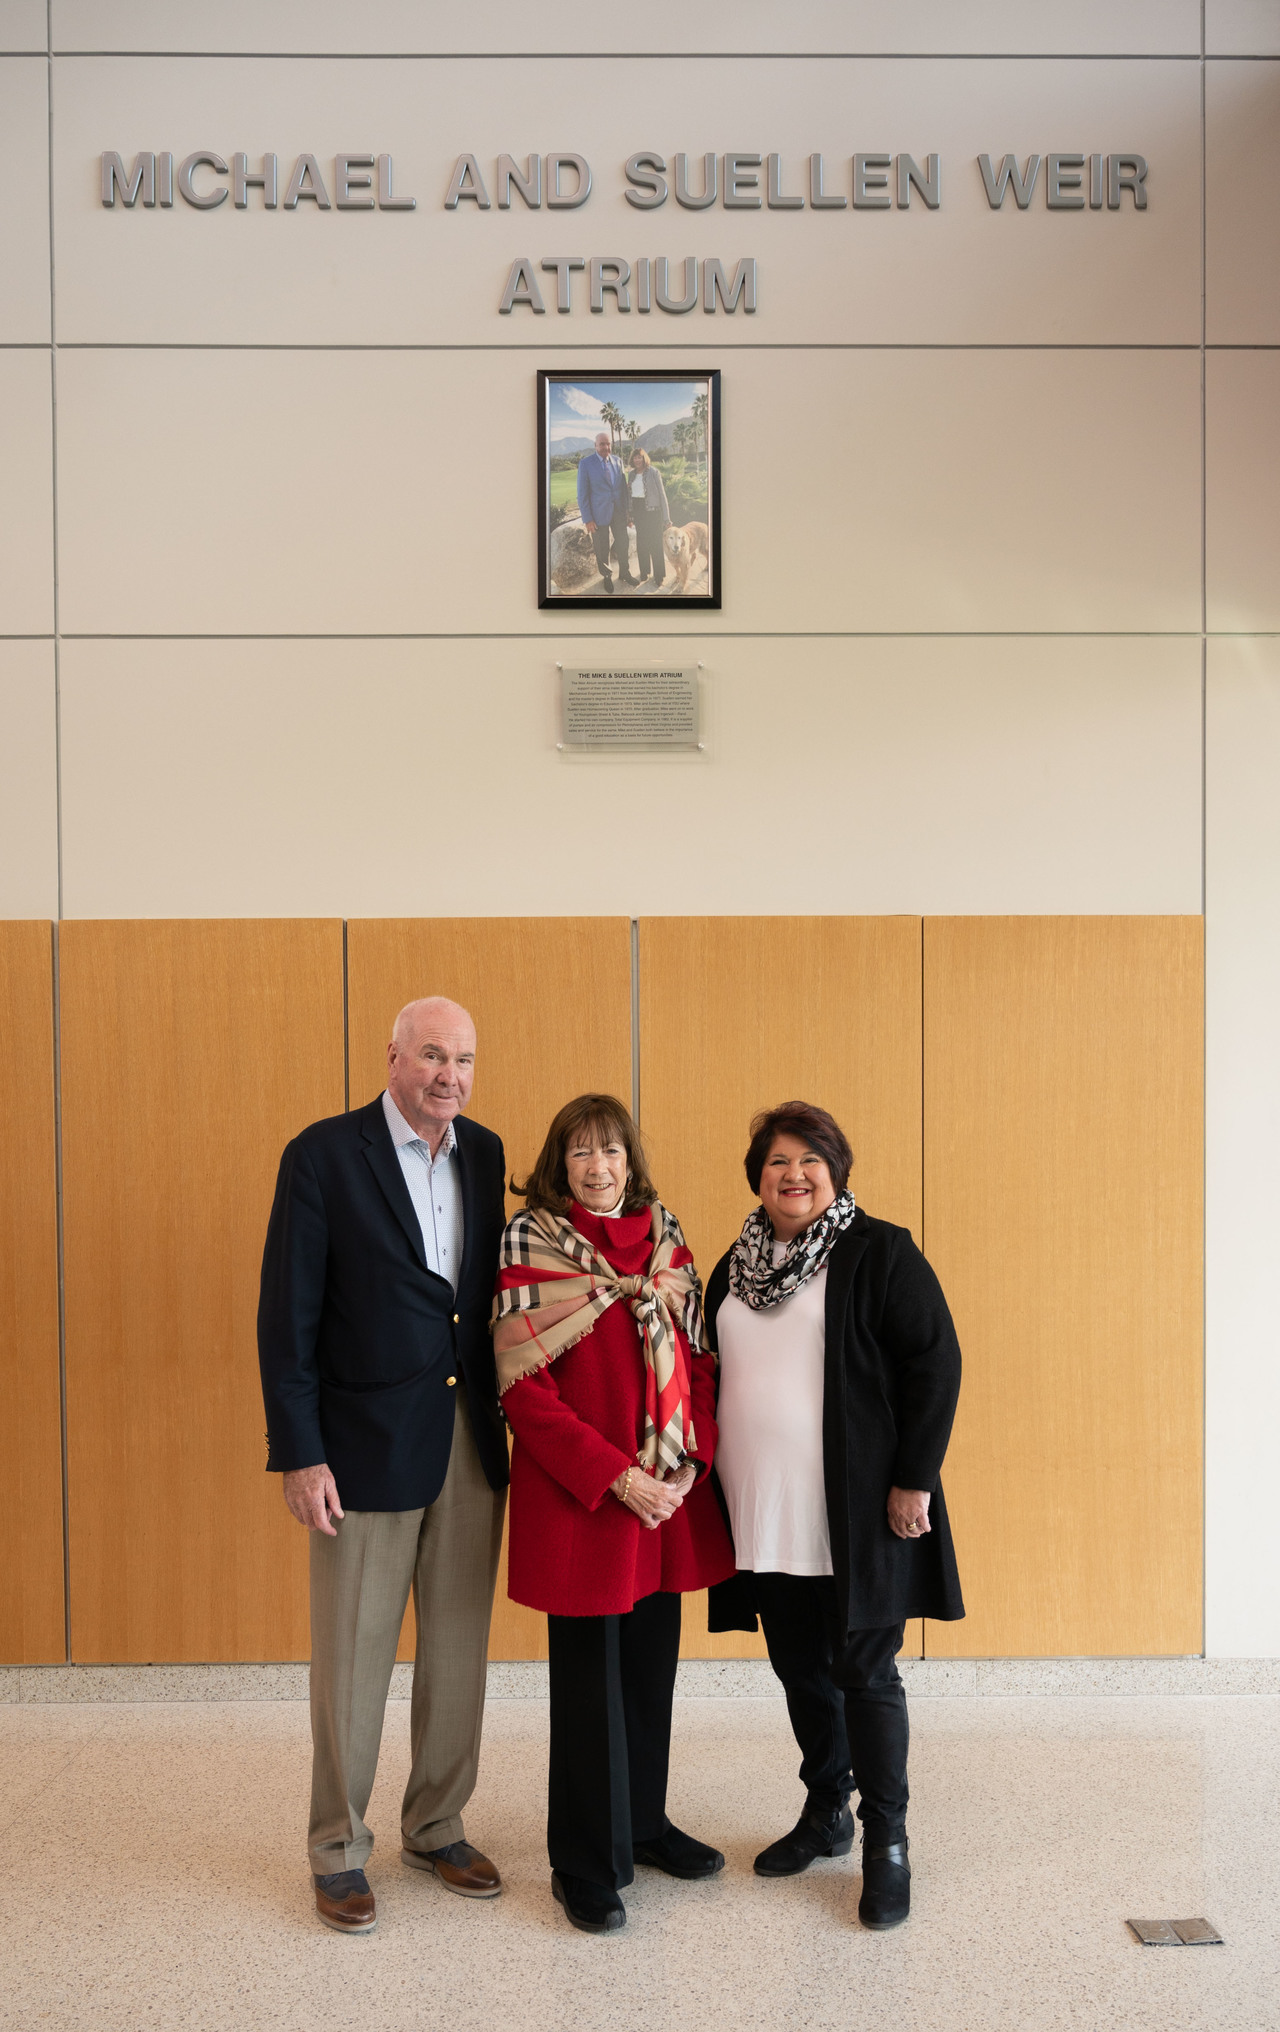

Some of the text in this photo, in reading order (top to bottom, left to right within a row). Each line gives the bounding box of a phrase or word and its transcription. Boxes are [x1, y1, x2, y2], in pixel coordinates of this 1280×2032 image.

[100, 151, 1148, 210] MICHAEL AND SUELLEN WEIR
[499, 257, 756, 313] ATRIUM
